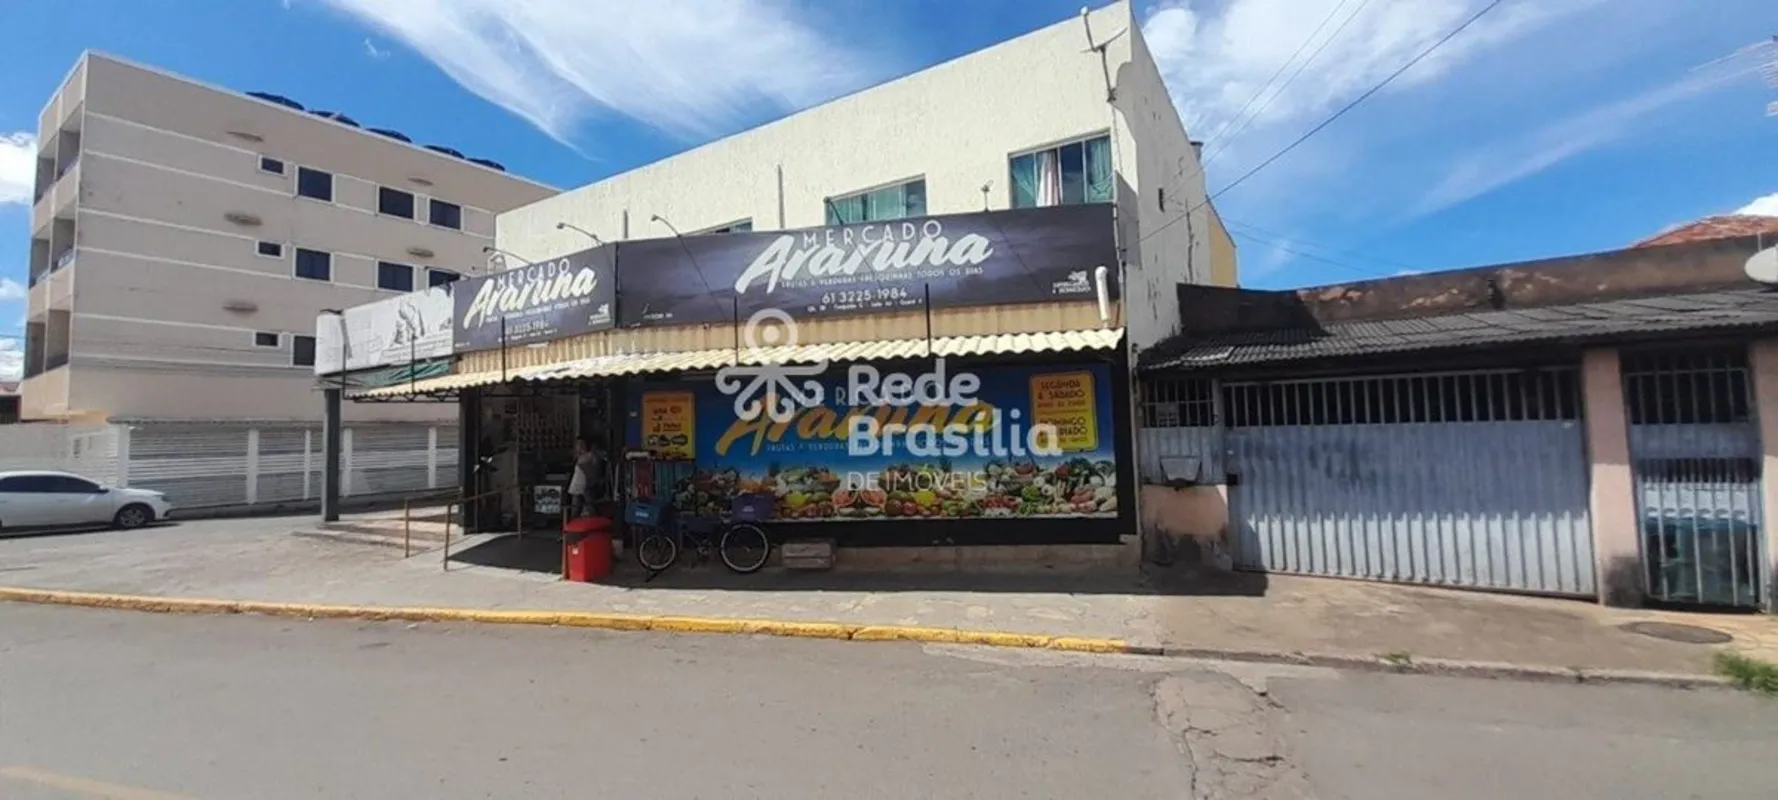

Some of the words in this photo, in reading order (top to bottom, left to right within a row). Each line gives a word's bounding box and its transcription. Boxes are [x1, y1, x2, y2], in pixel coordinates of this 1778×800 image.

[804, 220, 942, 249] MERCADO
[498, 259, 570, 289] MERCADO
[735, 233, 994, 294] Araruna
[949, 267, 961, 277] OS
[463, 267, 597, 329] Araruna
[821, 291, 836, 305] 61
